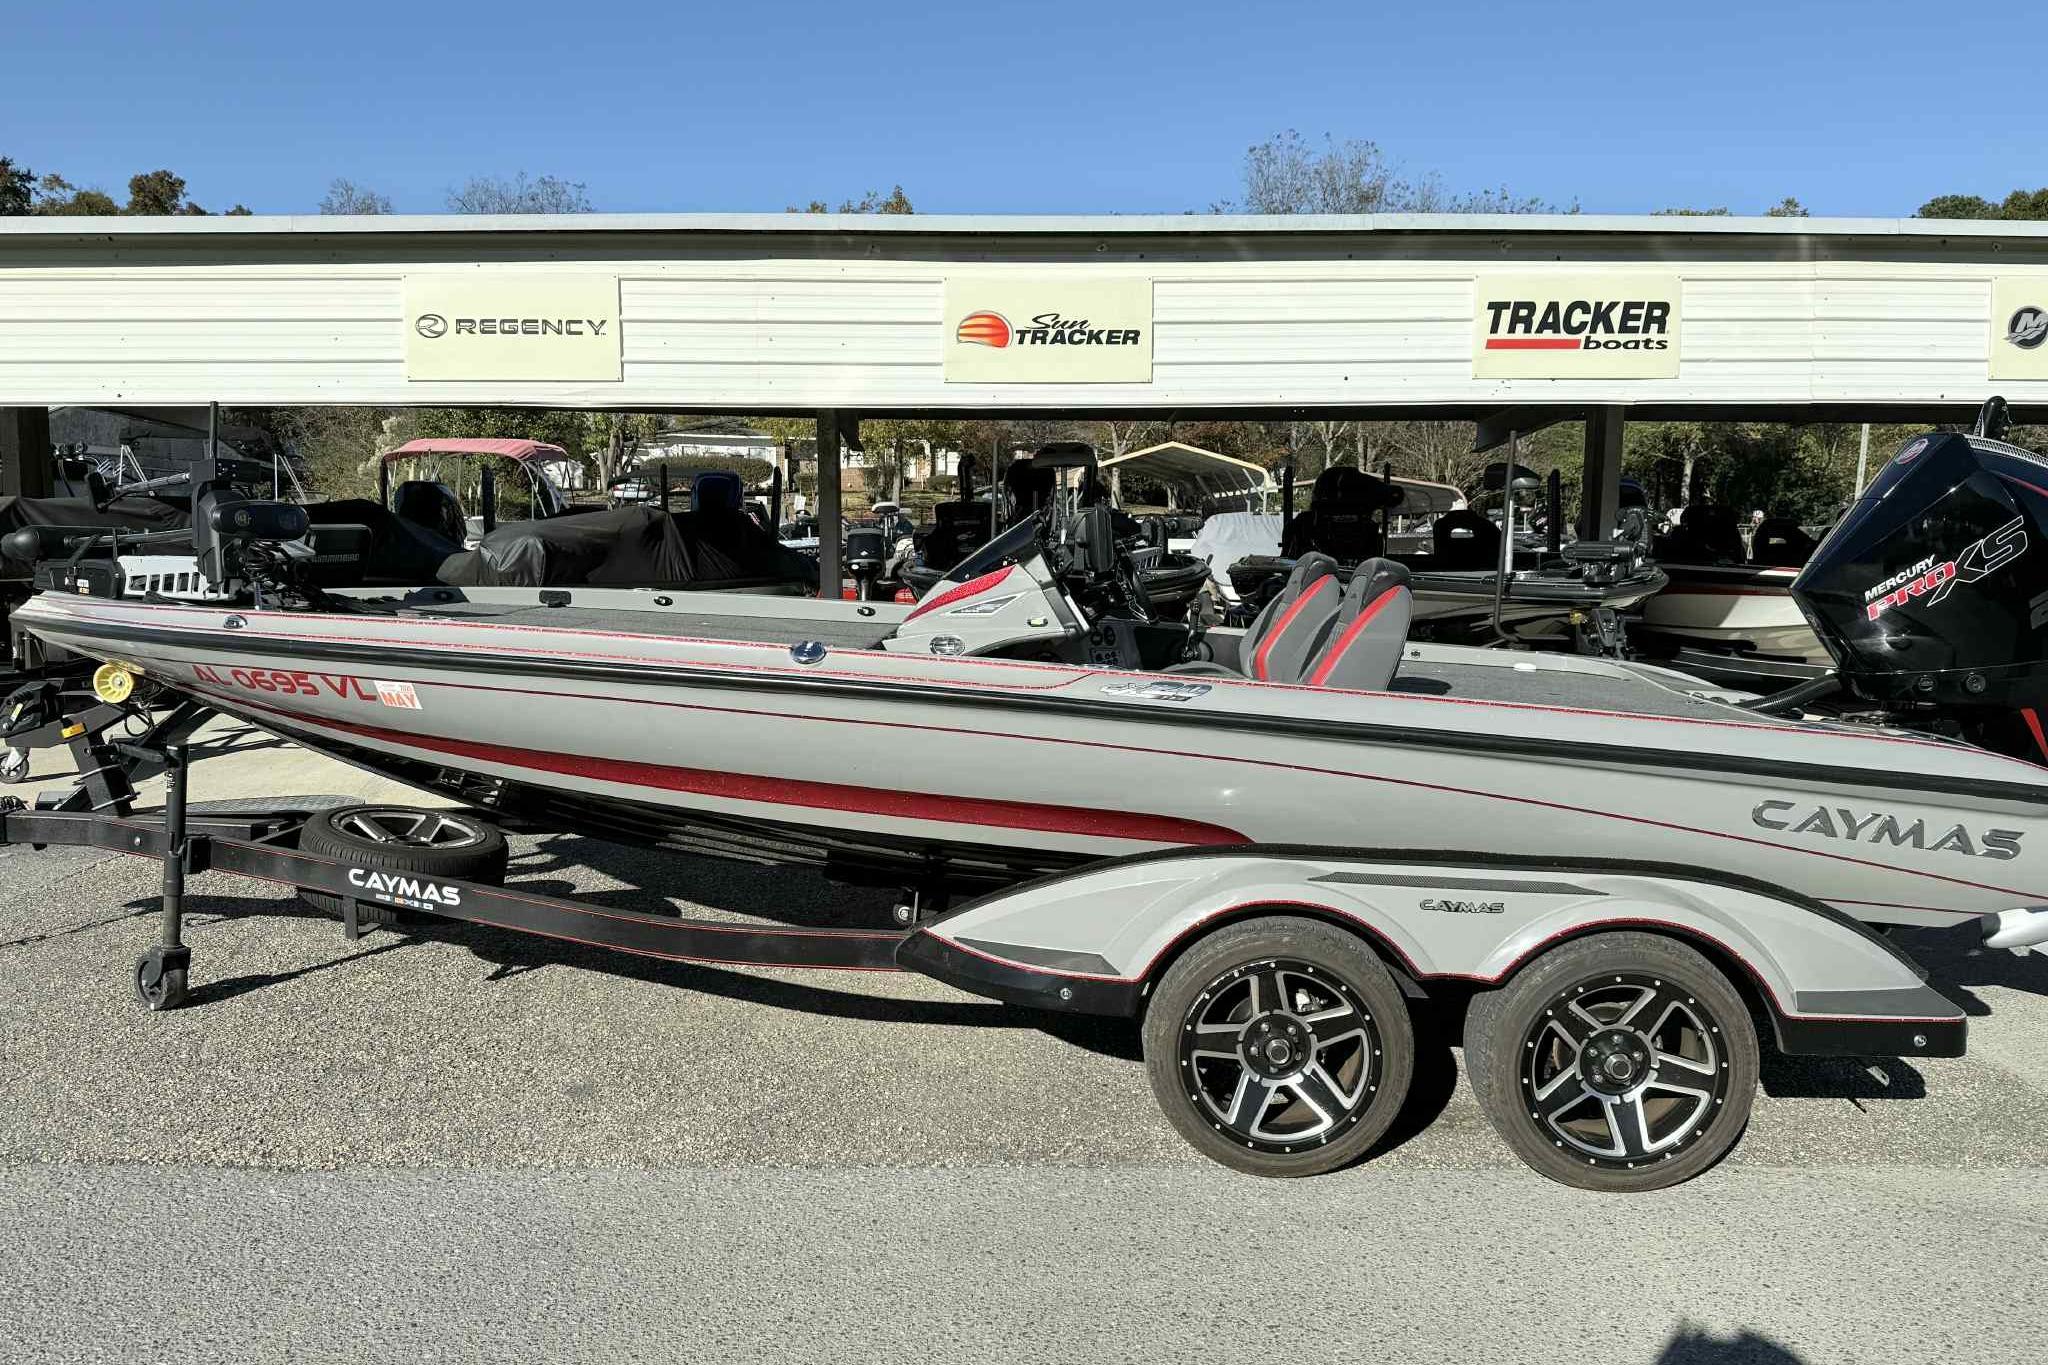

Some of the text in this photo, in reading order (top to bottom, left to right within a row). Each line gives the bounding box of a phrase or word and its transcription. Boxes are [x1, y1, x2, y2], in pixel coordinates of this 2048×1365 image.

[455, 318, 607, 335] REGENCY
[1025, 313, 1090, 330] Sun
[1486, 300, 1671, 335] TRACKER
[1015, 329, 1140, 345] TRACKER
[1583, 336, 1669, 350] boats
[1865, 554, 1935, 601] MERCURY
[192, 664, 378, 701] AL 0695 VL
[380, 690, 417, 709] MAY
[1751, 799, 2025, 861] CAYMAS
[348, 868, 461, 906] CAYMAS
[1419, 898, 1505, 914] CAYMAS
